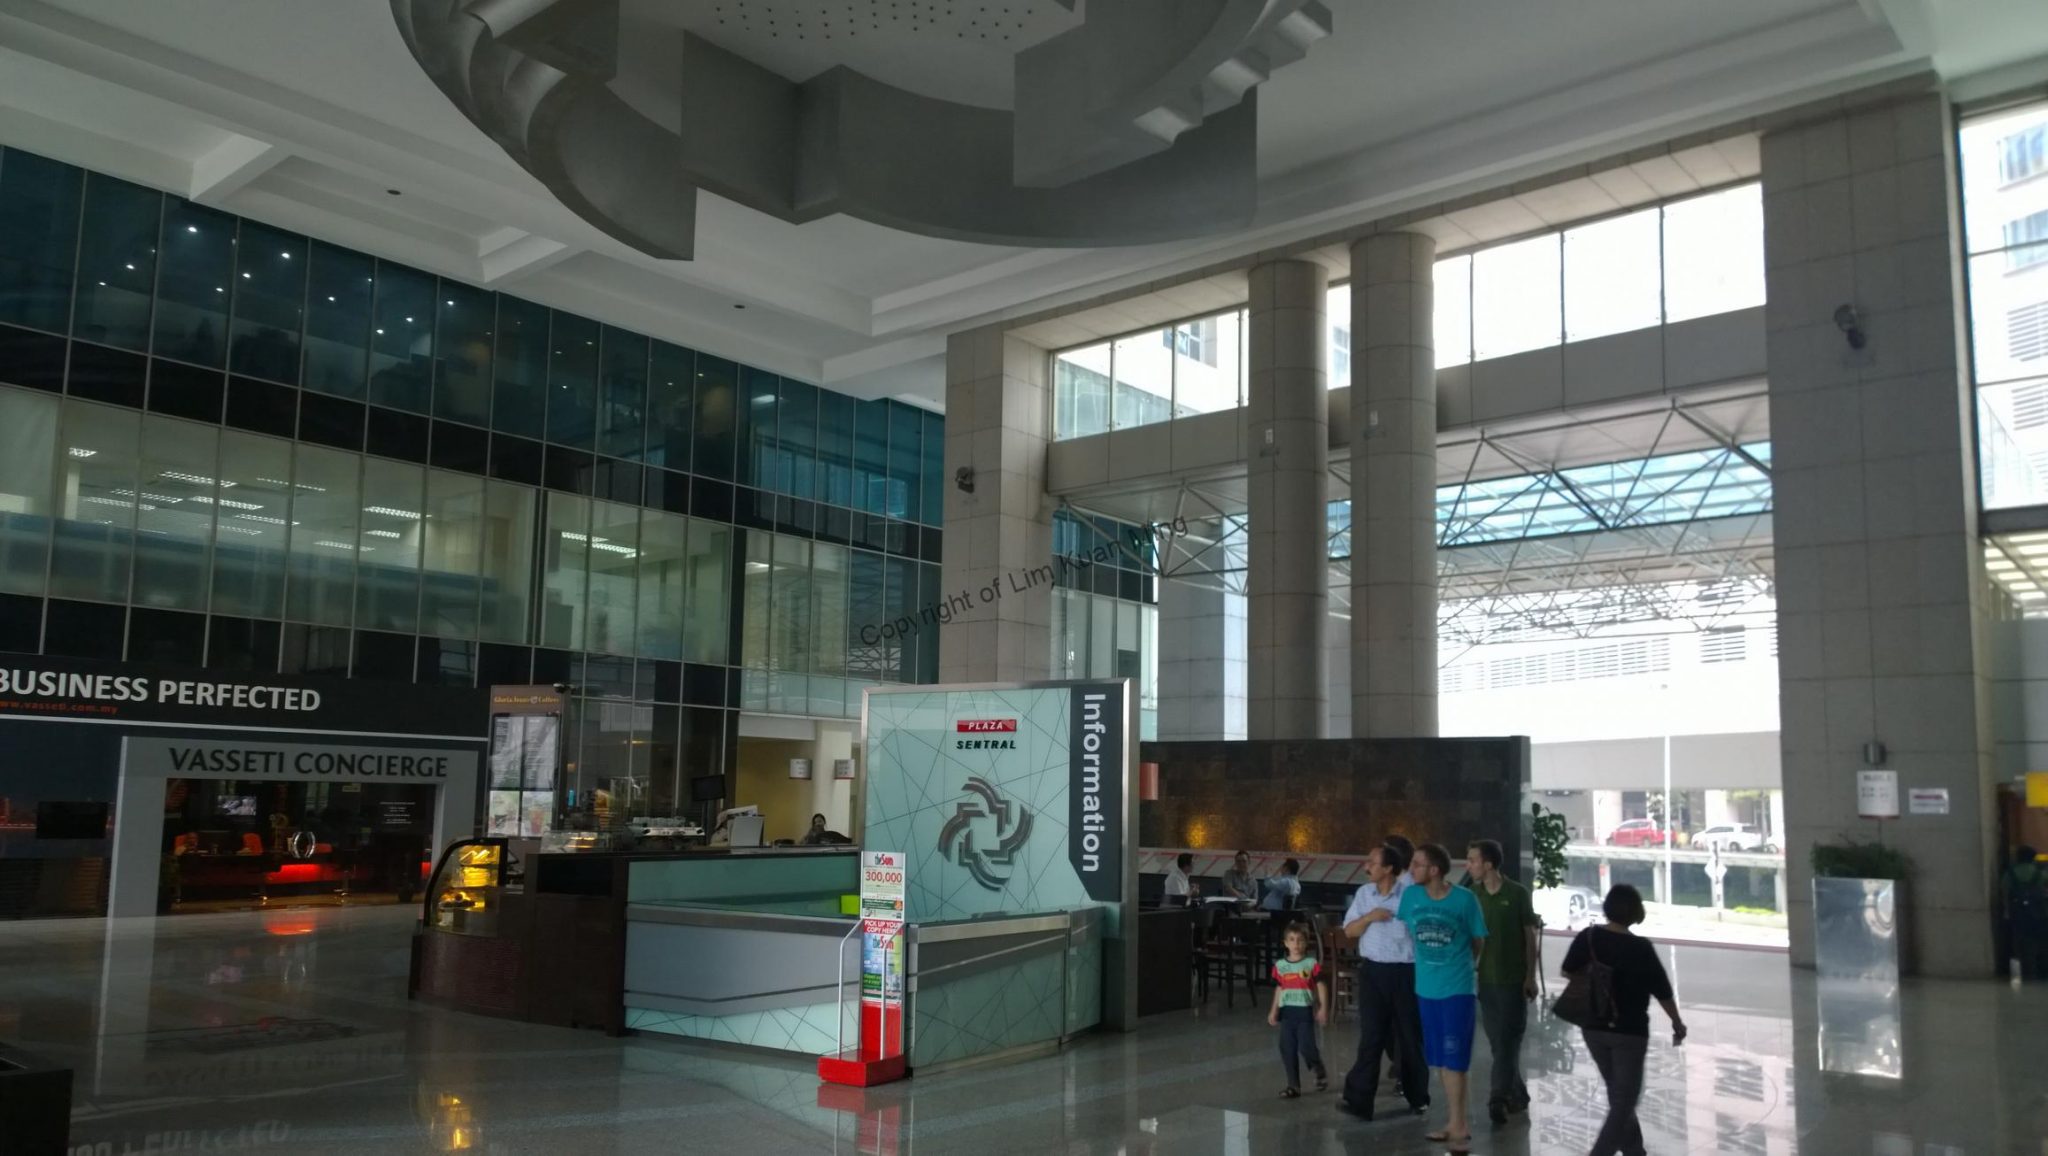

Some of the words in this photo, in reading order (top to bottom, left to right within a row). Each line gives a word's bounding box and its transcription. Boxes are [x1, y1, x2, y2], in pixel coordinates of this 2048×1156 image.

[158, 679, 321, 711] PERFECTED
[968, 722, 1004, 730] PLAZA
[956, 740, 1016, 749] SENTRAL
[169, 748, 285, 773] VASSETI
[294, 752, 449, 778] CONCIERGE
[1082, 694, 1106, 872] Information
[865, 871, 902, 883] 300,000
[877, 920, 886, 928] UP
